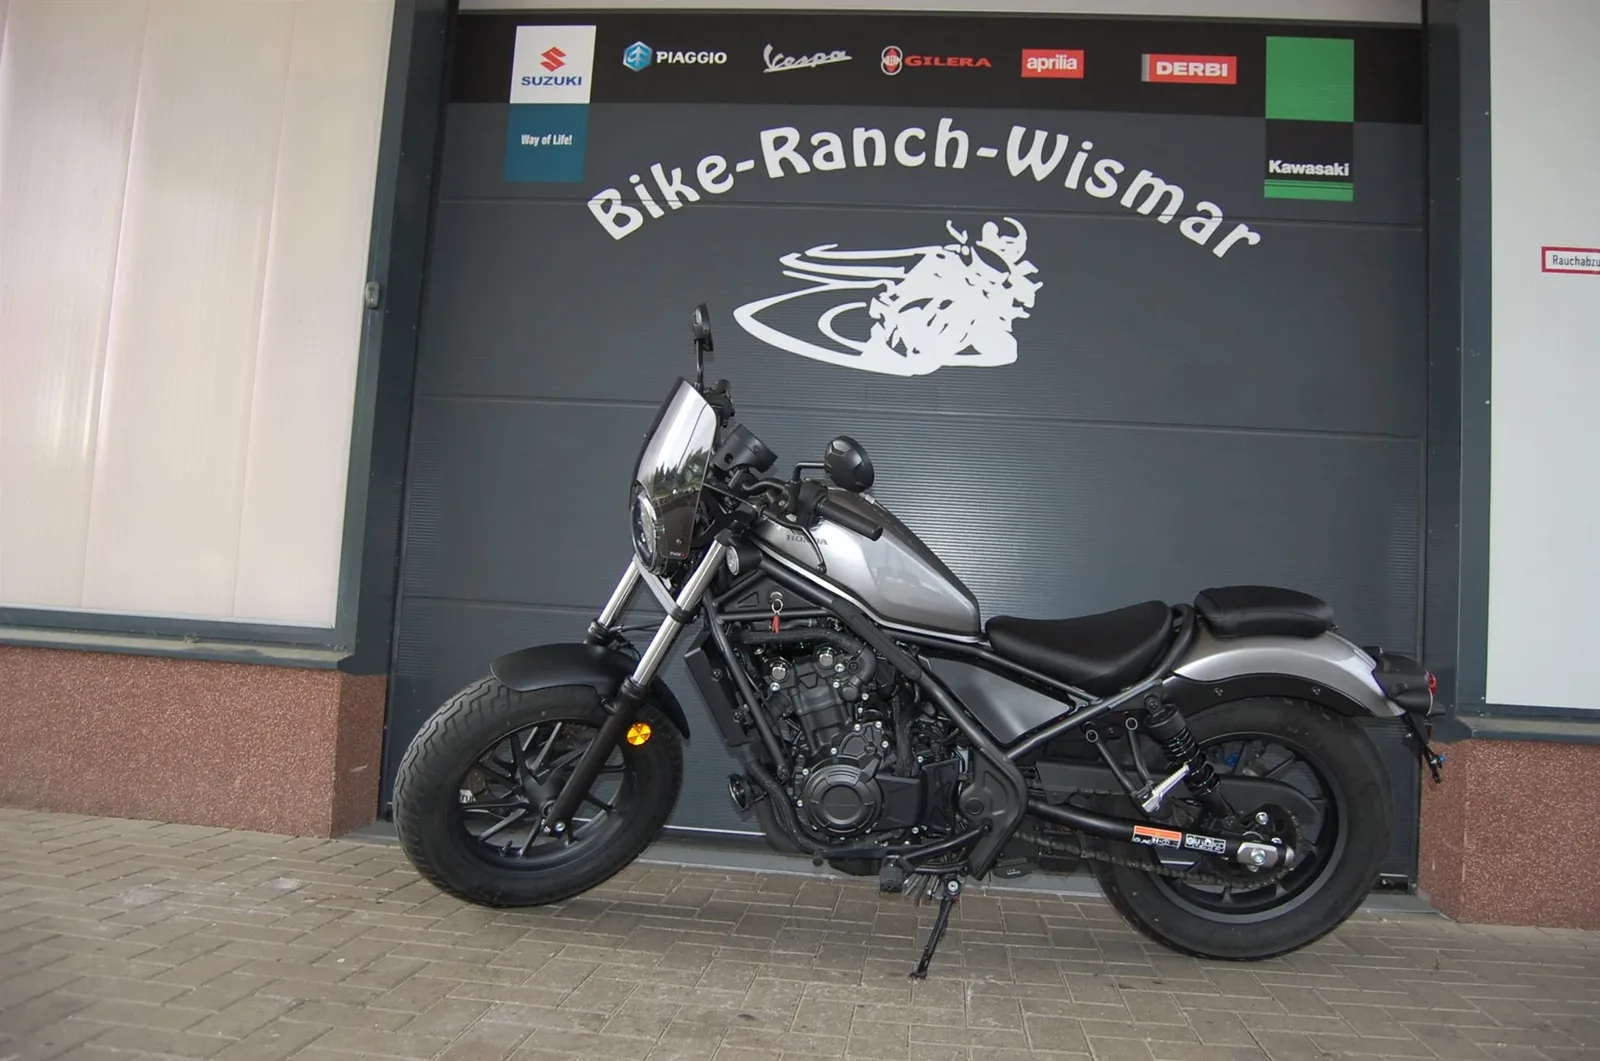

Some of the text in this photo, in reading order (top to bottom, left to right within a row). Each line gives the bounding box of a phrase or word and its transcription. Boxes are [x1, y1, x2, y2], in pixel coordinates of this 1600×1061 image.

[655, 51, 728, 65] PIAGGIO
[763, 43, 852, 73] Vespa
[904, 54, 993, 68] GILERA
[1026, 53, 1078, 73] aprilia
[1156, 61, 1229, 77] DERBI
[521, 76, 583, 86] SUZUKI
[521, 134, 573, 147] Way of Life!
[1268, 159, 1351, 177] Kawasaki
[588, 117, 1261, 258] Bike-Ranch-Wismar
